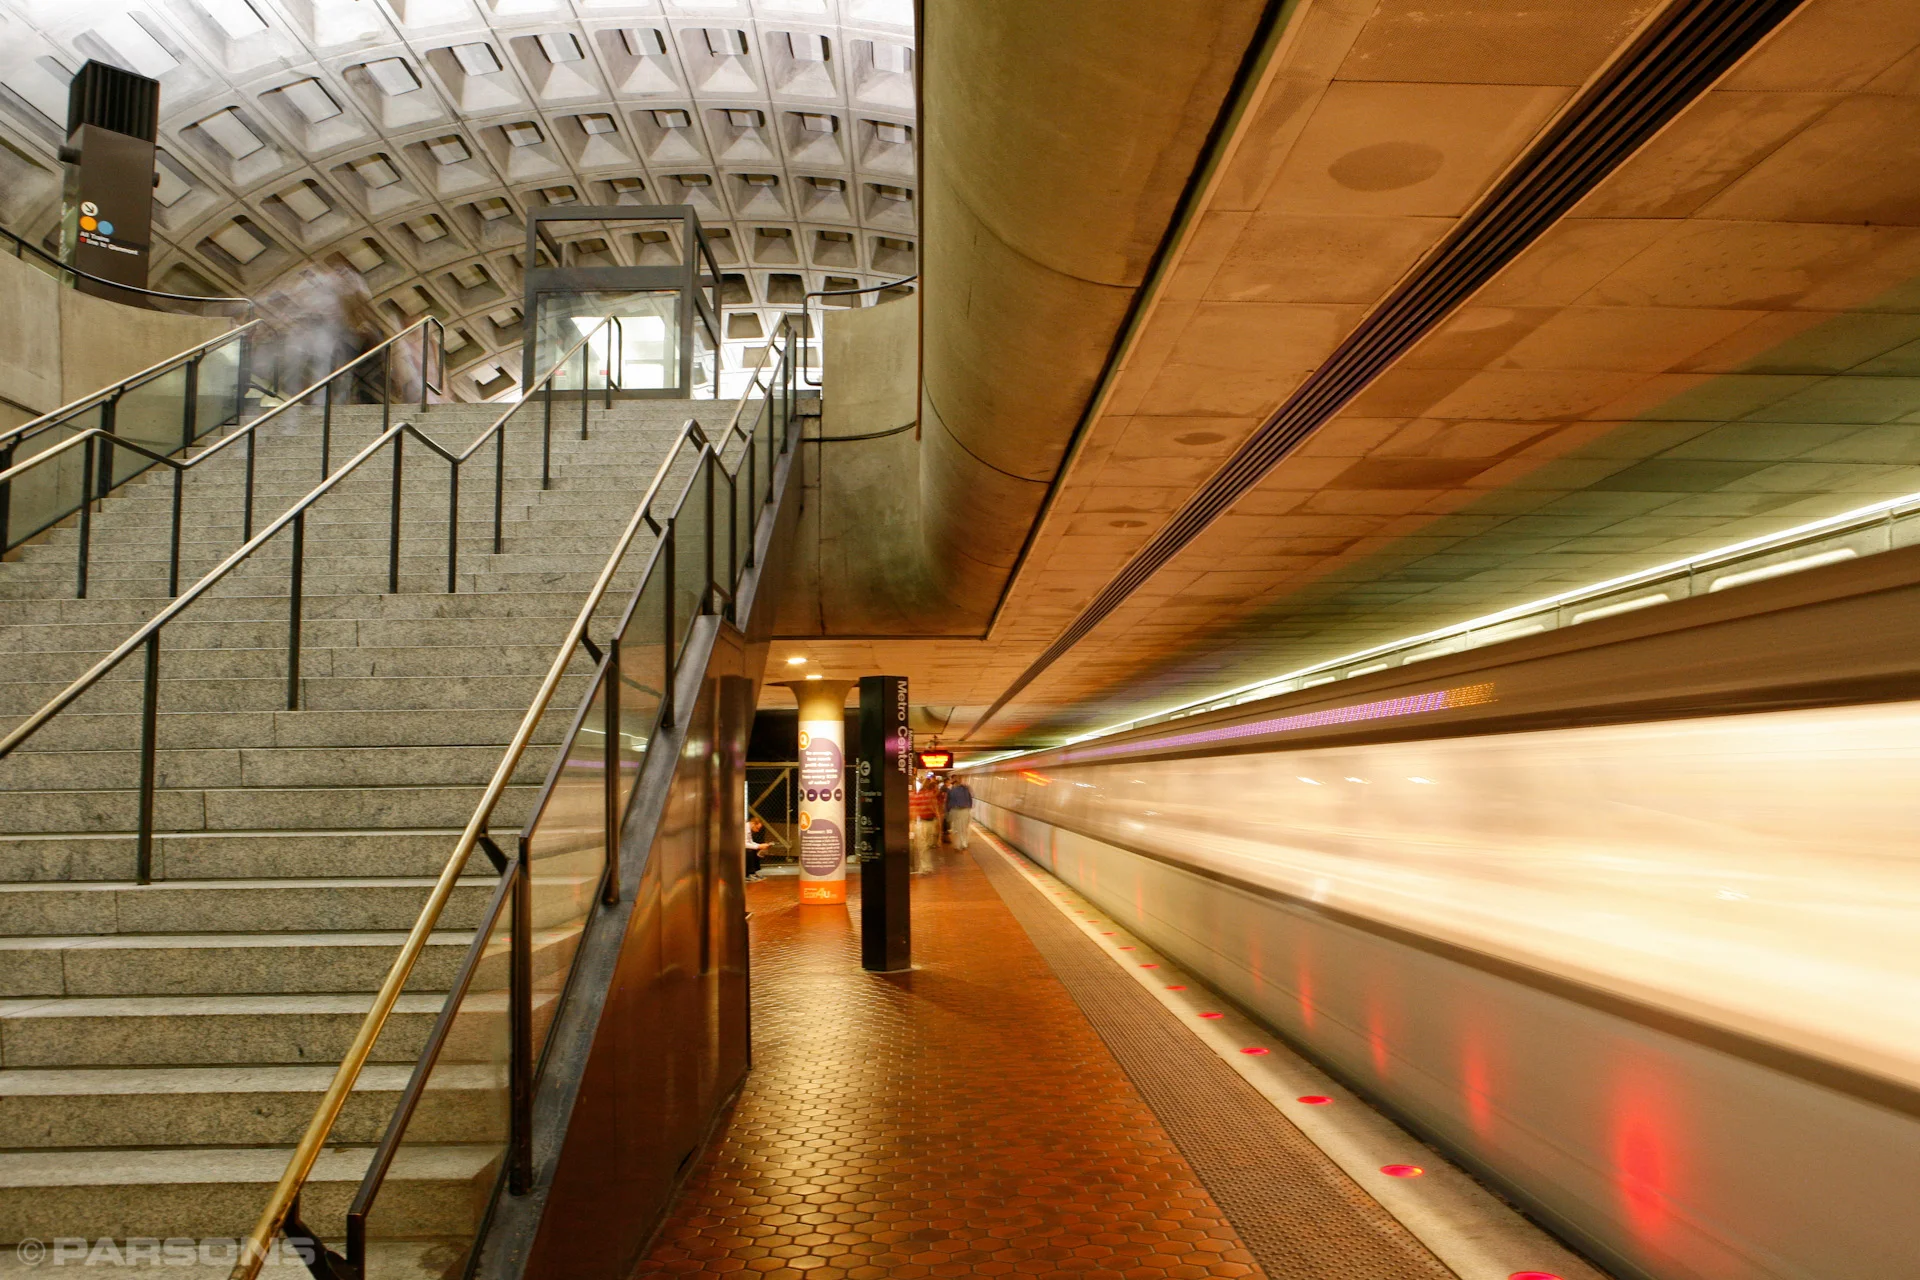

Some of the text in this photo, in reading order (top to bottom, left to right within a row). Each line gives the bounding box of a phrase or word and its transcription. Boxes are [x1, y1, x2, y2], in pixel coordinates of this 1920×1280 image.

[897, 681, 908, 773] Metro Center
[799, 734, 808, 746] Q
[800, 814, 809, 826] A
